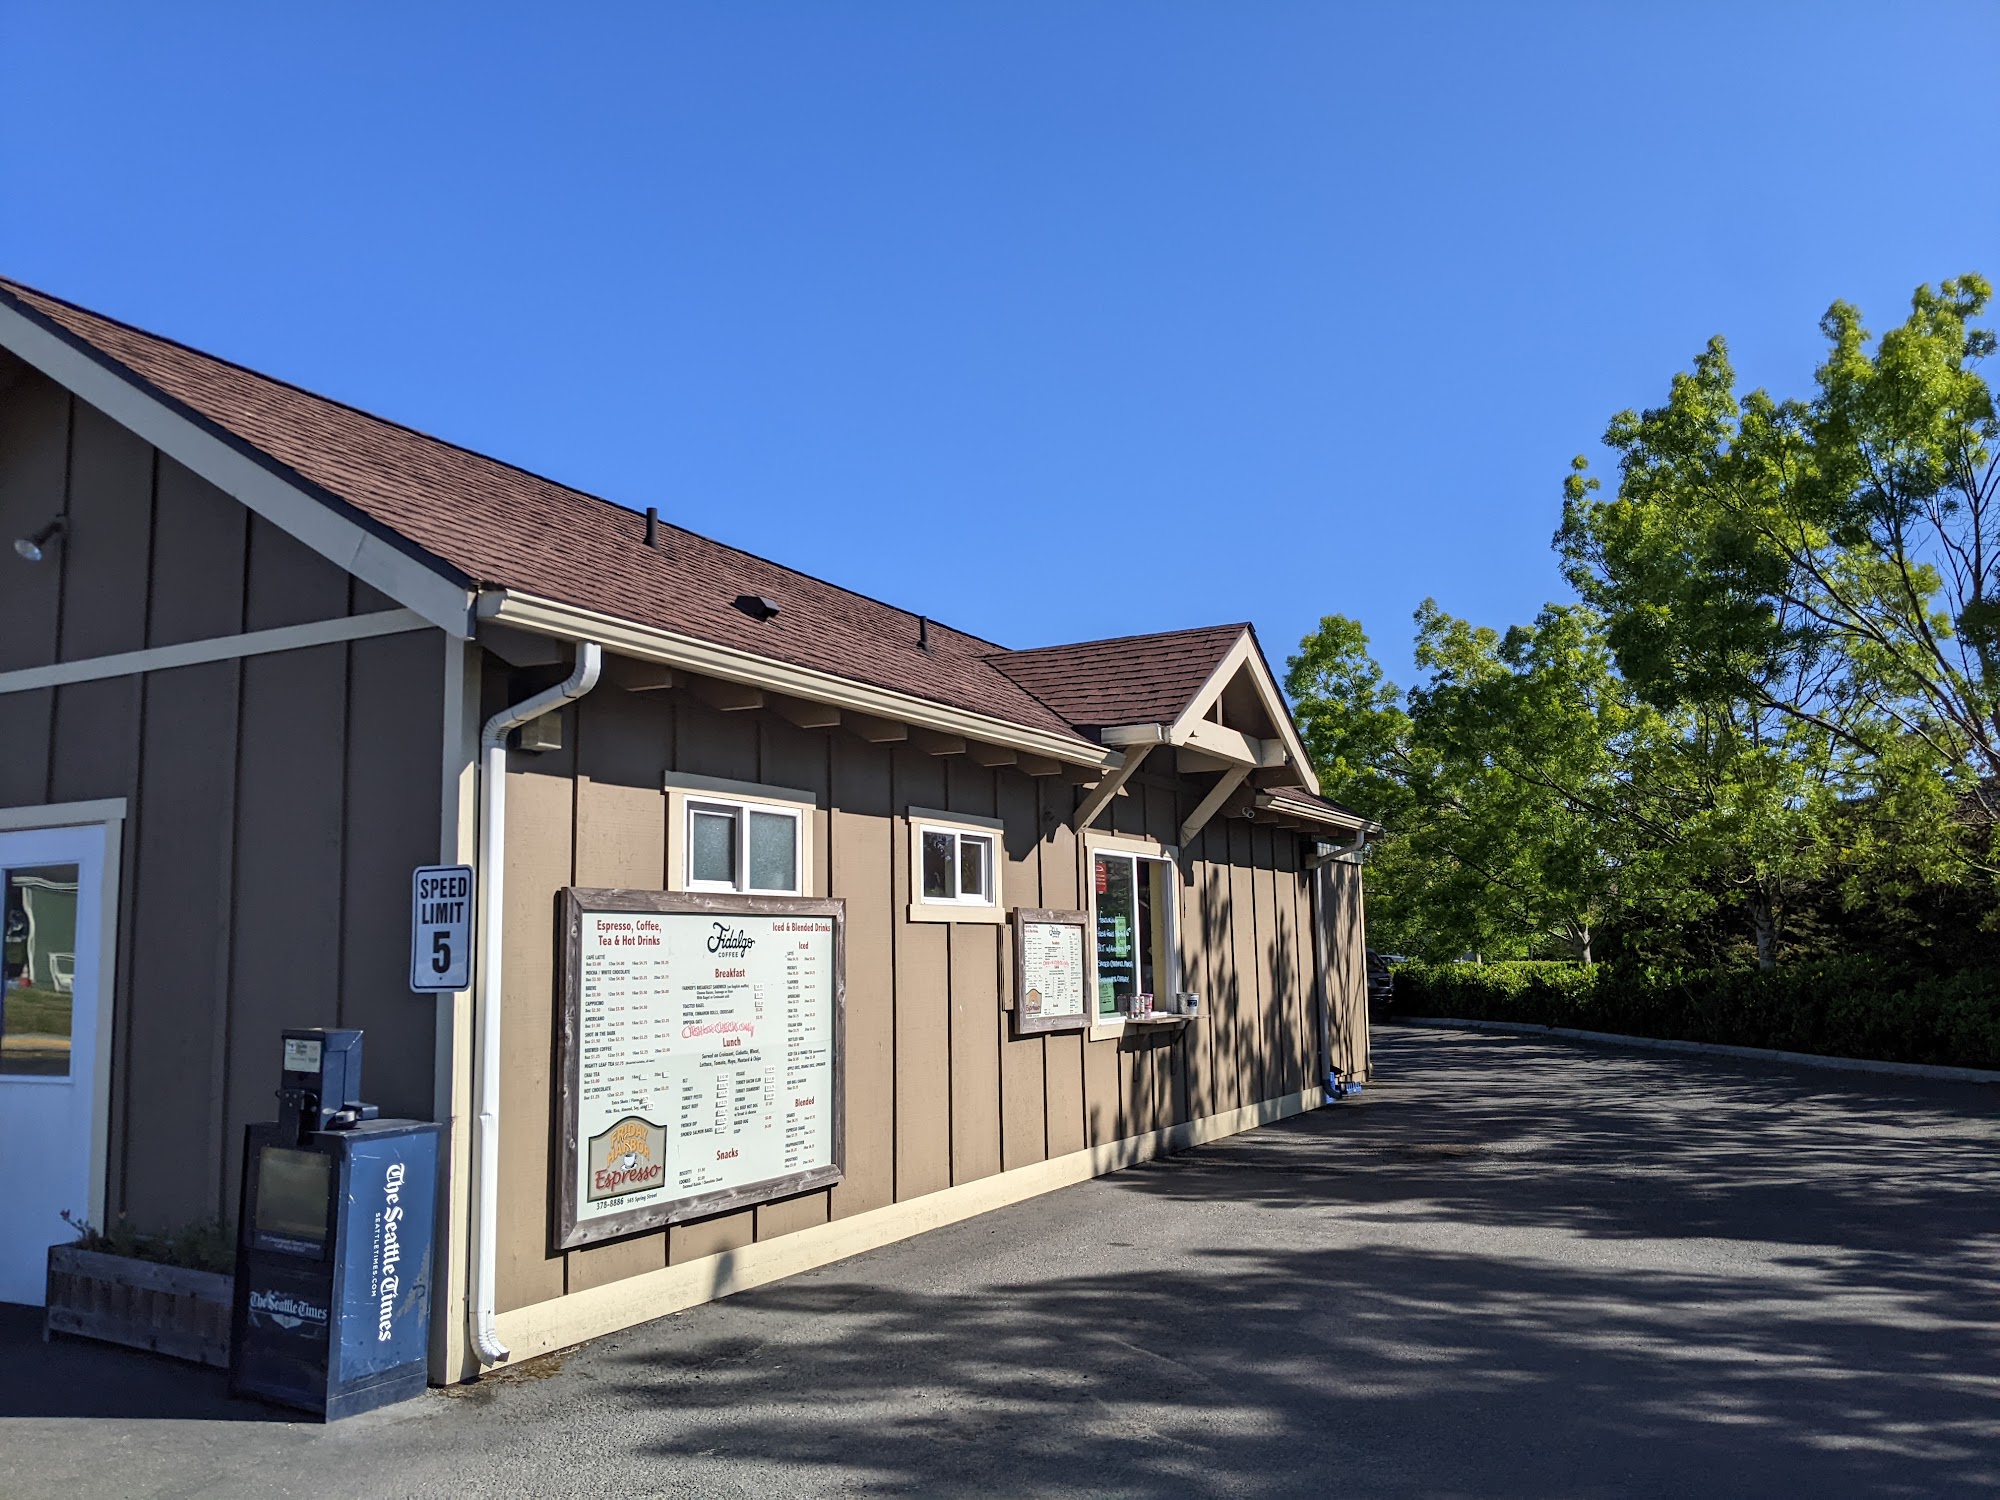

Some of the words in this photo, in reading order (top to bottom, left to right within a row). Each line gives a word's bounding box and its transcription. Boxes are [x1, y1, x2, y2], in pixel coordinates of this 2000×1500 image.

[420, 877, 467, 899] SPEED
[421, 902, 464, 925] LIMIT
[597, 920, 634, 933] Espresso,
[636, 920, 662, 933] Coffee,
[772, 922, 784, 932] Iced
[786, 922, 790, 932] &
[792, 922, 814, 932] Blended
[815, 923, 831, 932] Drinks
[598, 935, 612, 945] Tea
[615, 935, 620, 945] &
[622, 935, 635, 945] Hot
[637, 935, 660, 945] Drinks
[707, 921, 756, 958] Fidalgo
[799, 941, 809, 950] Iced
[432, 931, 451, 974] 5
[715, 967, 746, 978] Breakfast
[723, 1036, 741, 1048] Lunch
[795, 1096, 815, 1108] Blended
[611, 1123, 649, 1148] FRIDAY
[607, 1138, 651, 1169] HARBOR
[716, 1147, 739, 1161] Snacks
[383, 1162, 406, 1206] The
[595, 1164, 661, 1192] Espresso
[596, 1198, 624, 1210] 378-8886
[635, 1195, 646, 1203] Spring
[382, 1206, 404, 1276] Seattle
[371, 1212, 381, 1297] SEATTLETIMES.COM
[249, 1291, 267, 1308] The
[266, 1294, 298, 1315] Seattle
[298, 1300, 328, 1320] Times
[378, 1274, 399, 1342] Times
